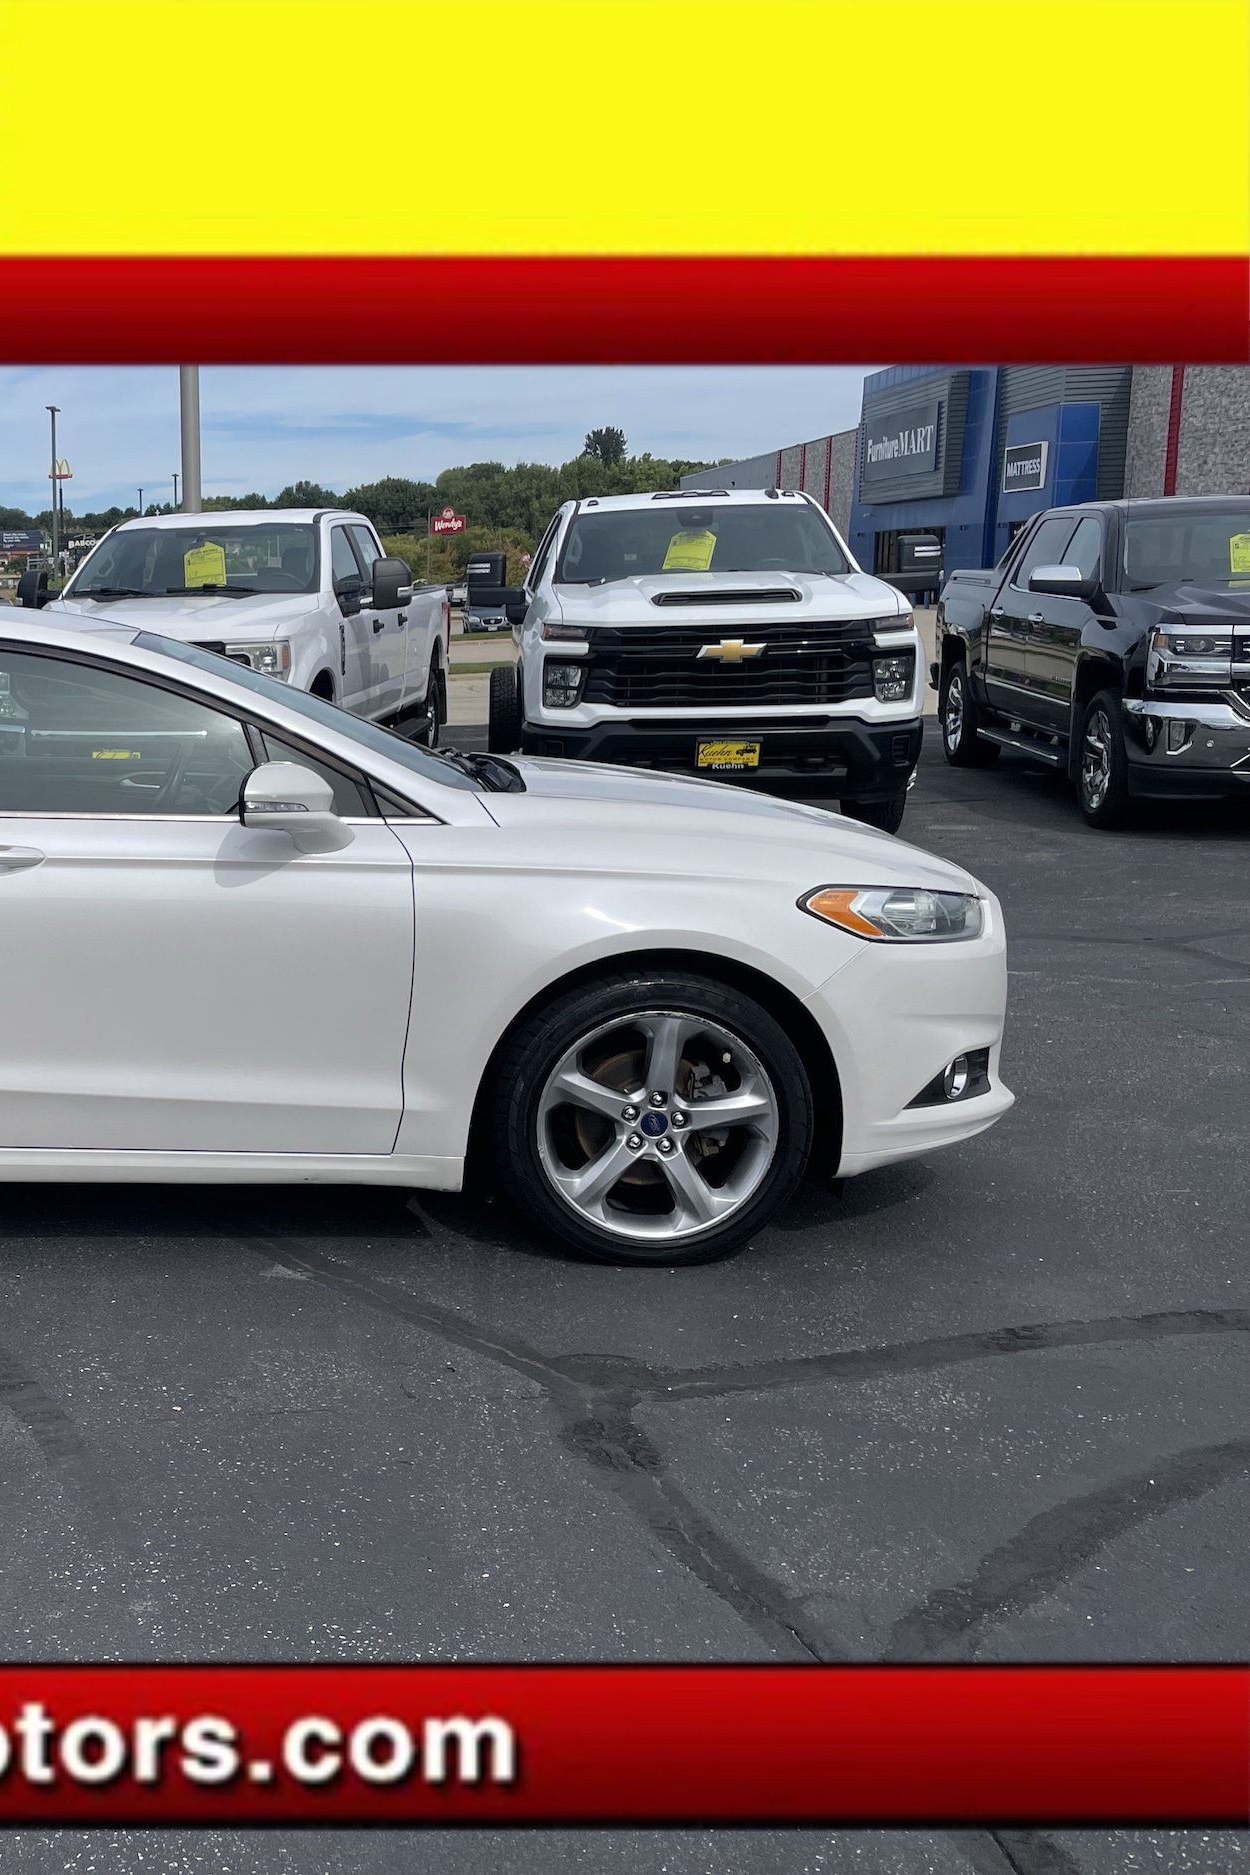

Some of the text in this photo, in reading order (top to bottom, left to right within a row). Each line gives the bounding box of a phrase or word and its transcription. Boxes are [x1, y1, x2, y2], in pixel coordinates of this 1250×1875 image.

[1007, 458, 1040, 477] MATTRESS
[435, 518, 463, 531] Wendy's
[699, 744, 732, 758] Kuehn
